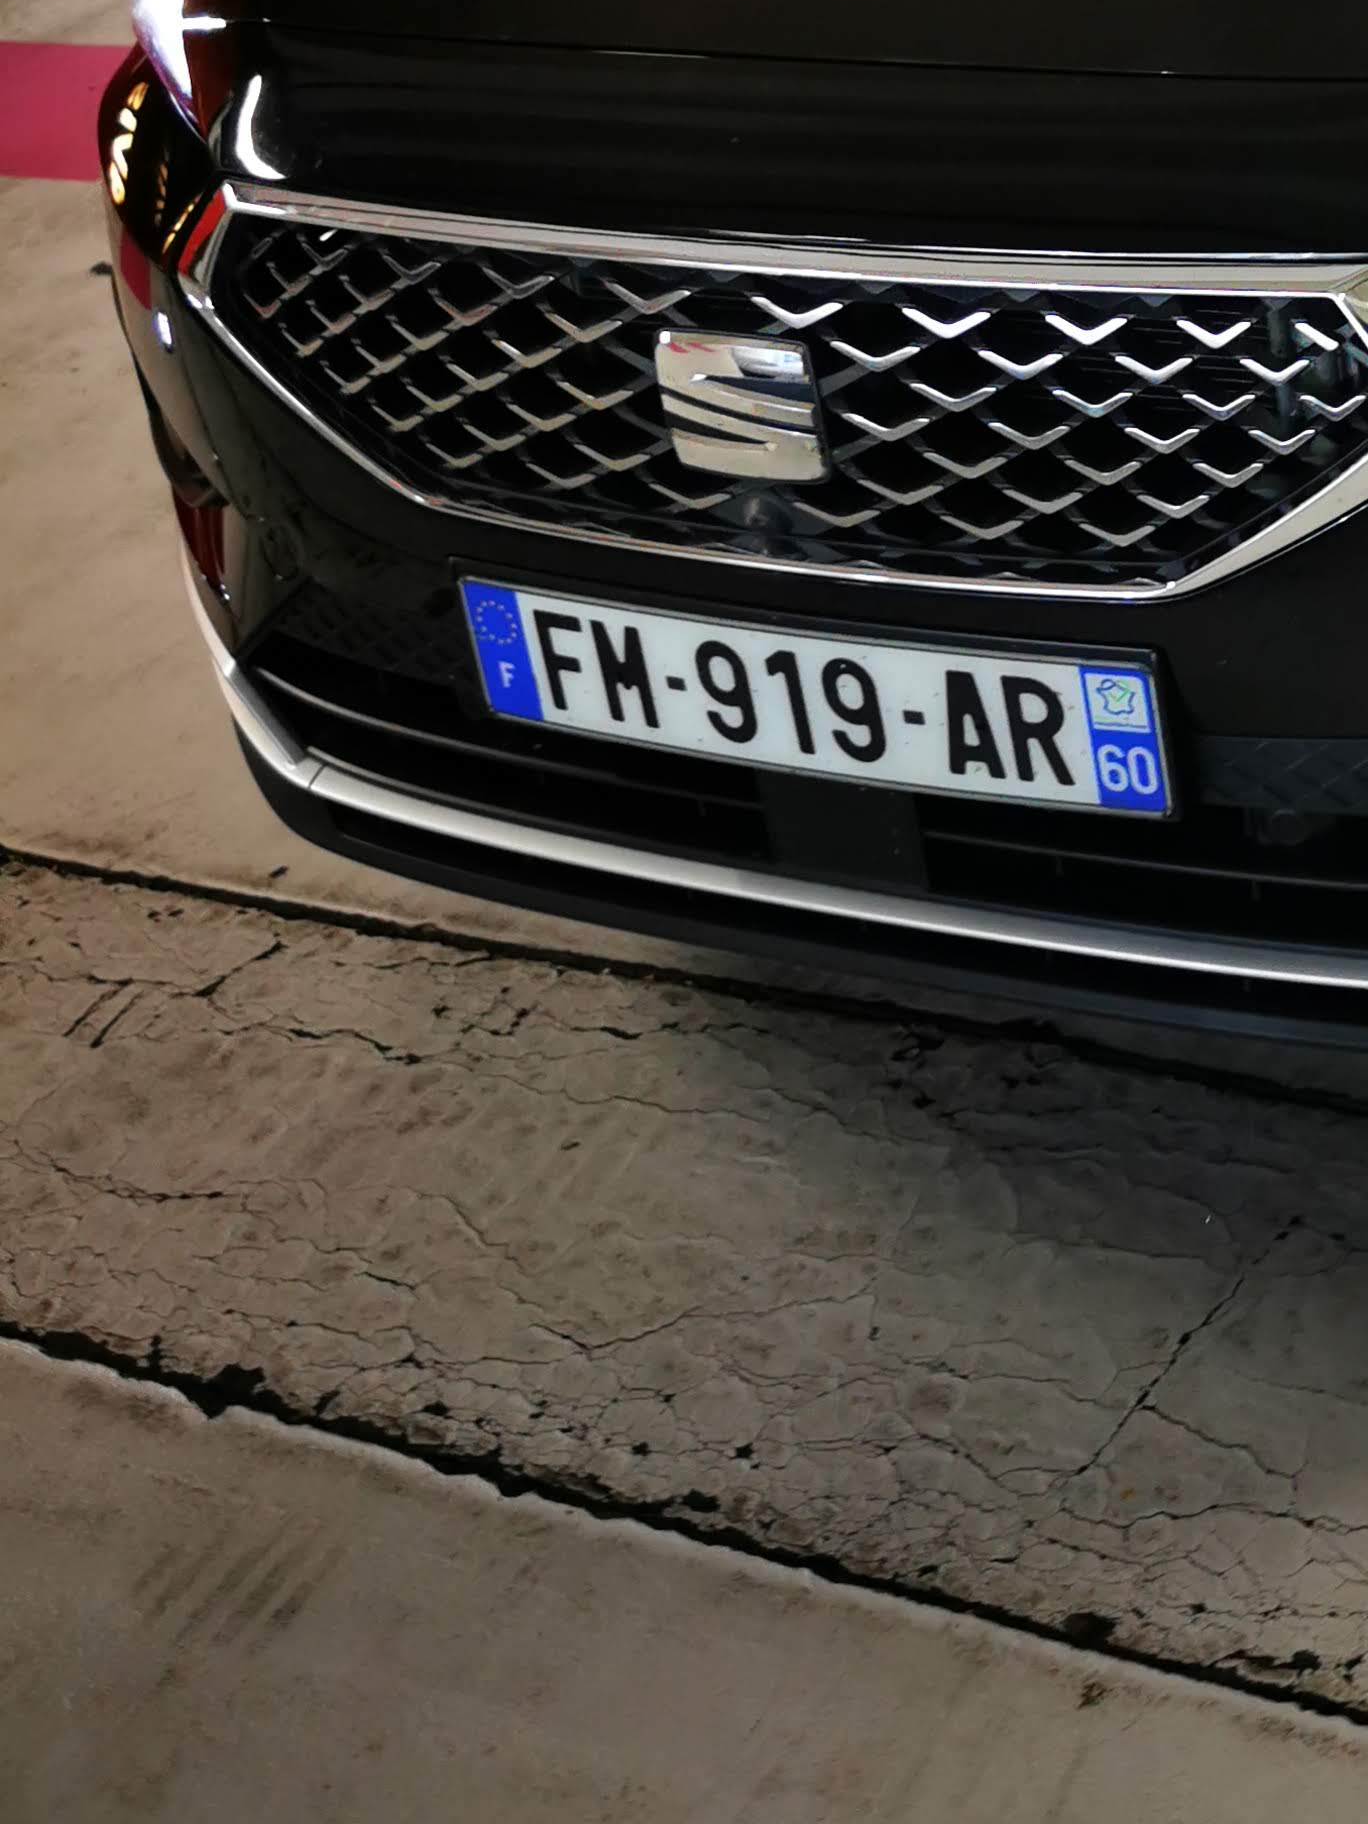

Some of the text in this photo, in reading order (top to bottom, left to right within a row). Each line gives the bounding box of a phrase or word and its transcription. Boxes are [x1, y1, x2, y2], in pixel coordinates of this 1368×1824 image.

[499, 661, 515, 687] F
[533, 609, 1076, 786] FM-919-AR
[1097, 744, 1160, 795] 60
